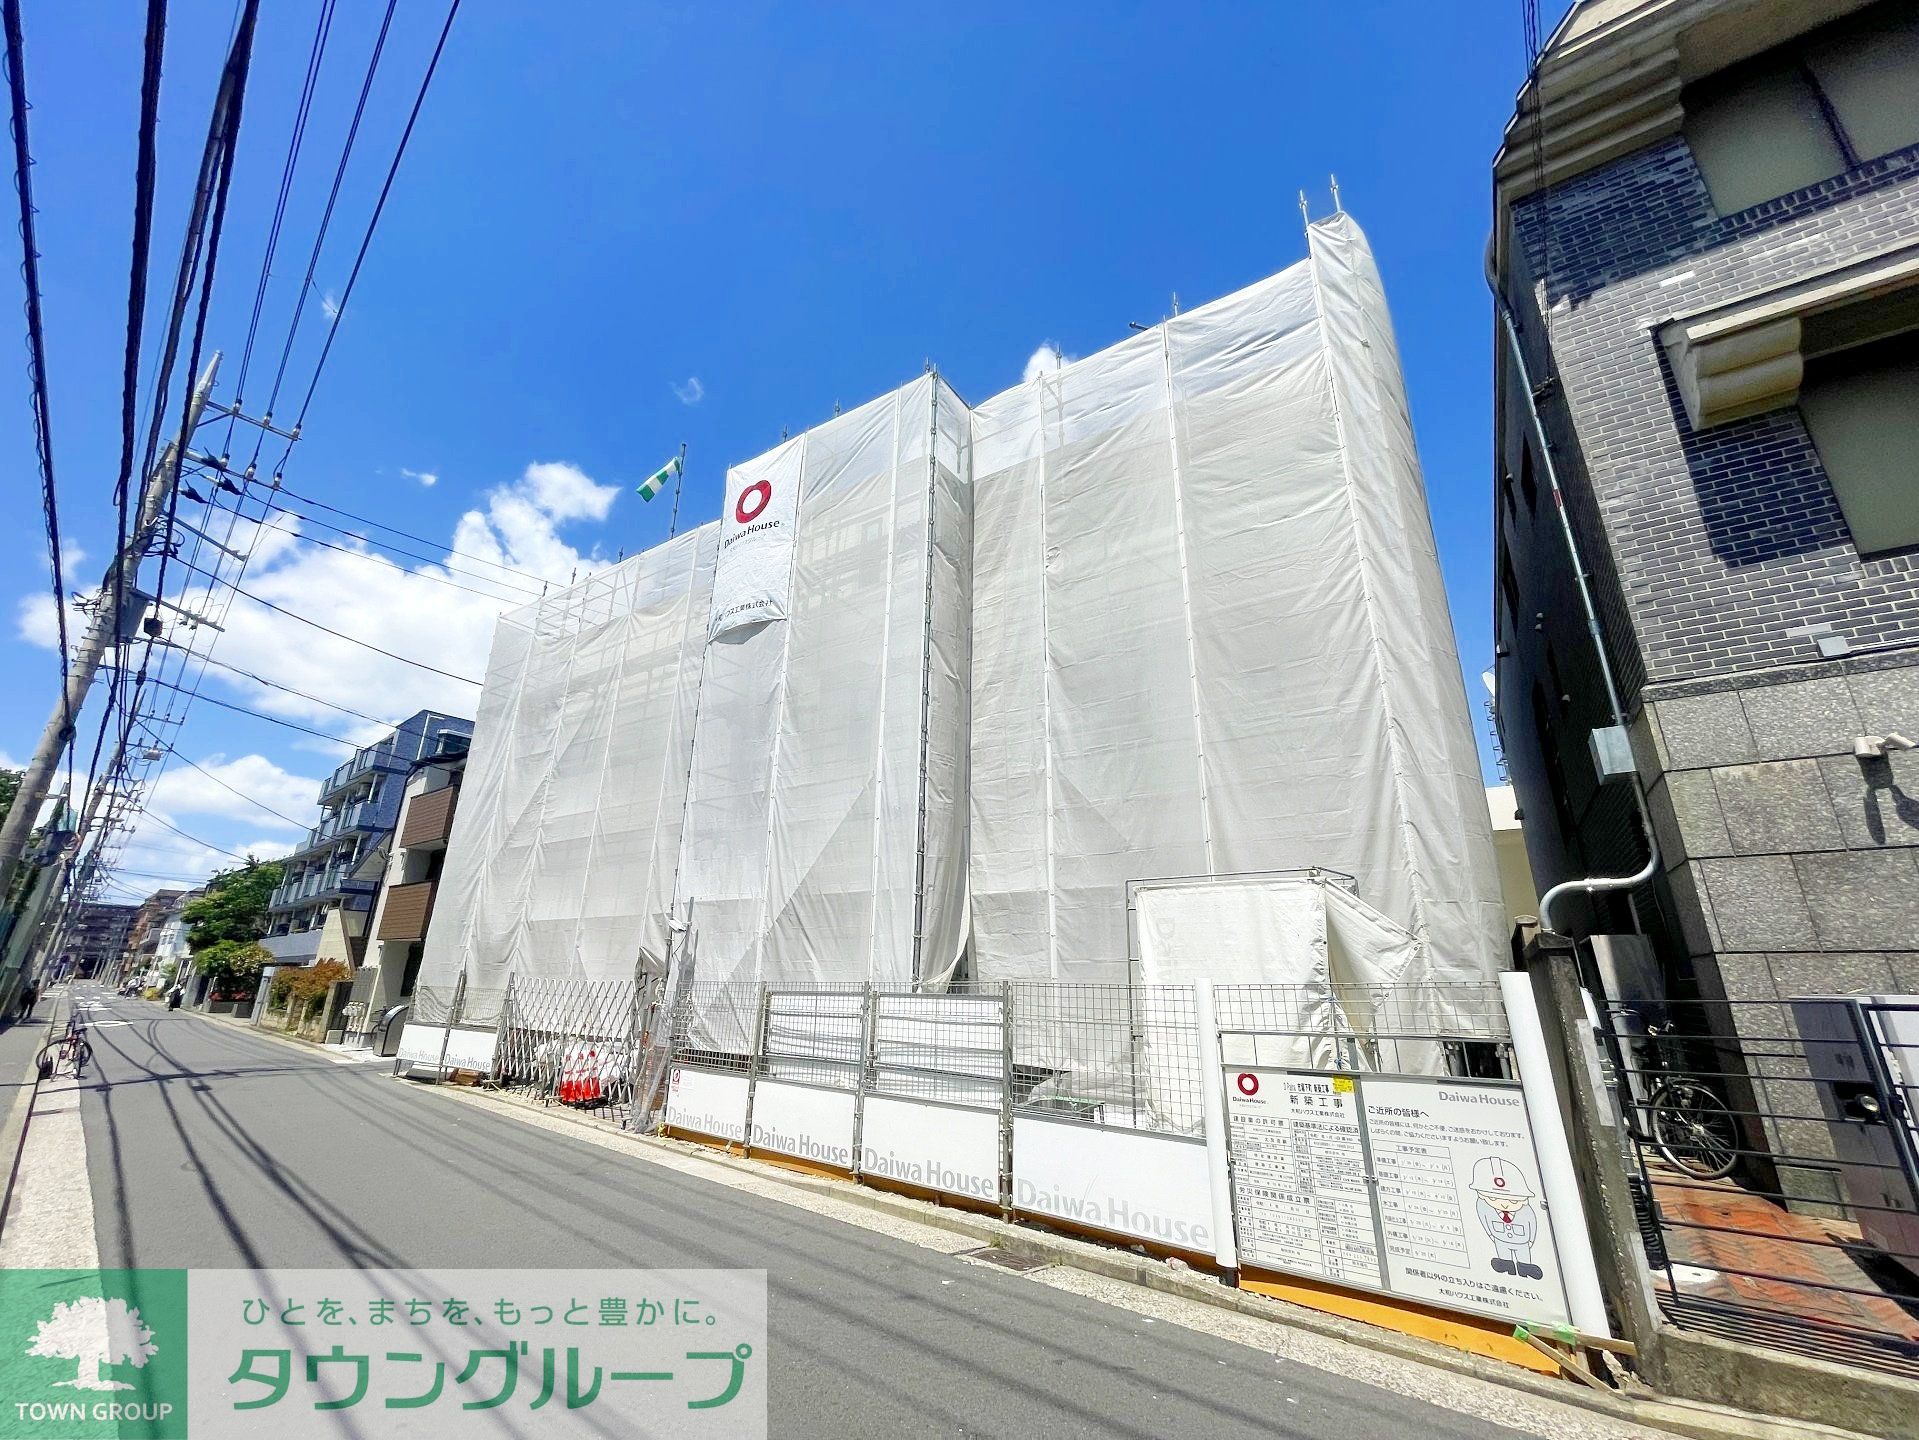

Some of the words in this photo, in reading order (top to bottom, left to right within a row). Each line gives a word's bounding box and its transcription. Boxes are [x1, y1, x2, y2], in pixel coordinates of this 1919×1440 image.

[747, 520, 780, 535] House
[444, 1053, 467, 1067] Daiwa
[467, 1056, 491, 1070] House
[1290, 1094, 1343, 1109] 新築工事
[1438, 1091, 1478, 1104] Daiwa
[1478, 1093, 1520, 1107] House
[1368, 1105, 1429, 1118] ご近所の皆様へ
[667, 1105, 702, 1130] Daiwa
[703, 1112, 743, 1140] House
[752, 1123, 796, 1153] Daiwa
[798, 1133, 849, 1165] House
[864, 1147, 923, 1183] Daiwa
[926, 1159, 994, 1198] House
[1238, 1186, 1311, 1204] 労災保険関係成立票
[1016, 1177, 1102, 1225] Daiwa
[1107, 1195, 1210, 1248] House
[1438, 1287, 1510, 1308] 大和ハウス工業株式会社
